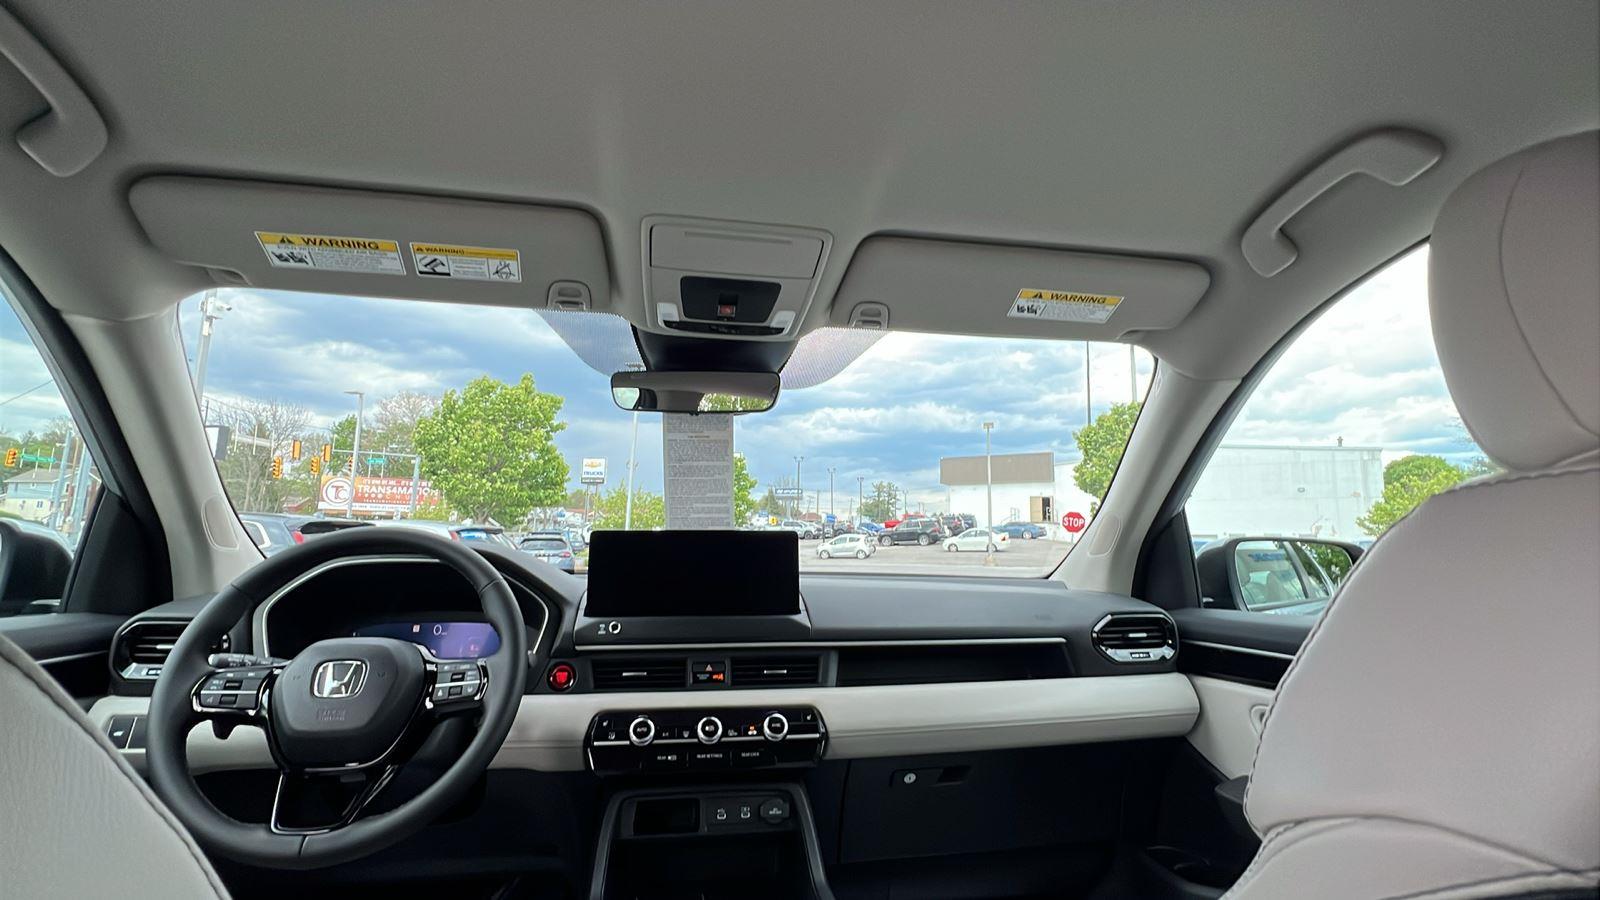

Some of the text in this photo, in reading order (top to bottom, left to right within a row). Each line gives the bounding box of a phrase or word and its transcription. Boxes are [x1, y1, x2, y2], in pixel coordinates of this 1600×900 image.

[301, 236, 379, 250] WARNING
[425, 247, 465, 255] WARNING
[1050, 292, 1107, 304] WARNING
[357, 485, 439, 496] TRANS4MAION
[1063, 517, 1085, 527] STOP
